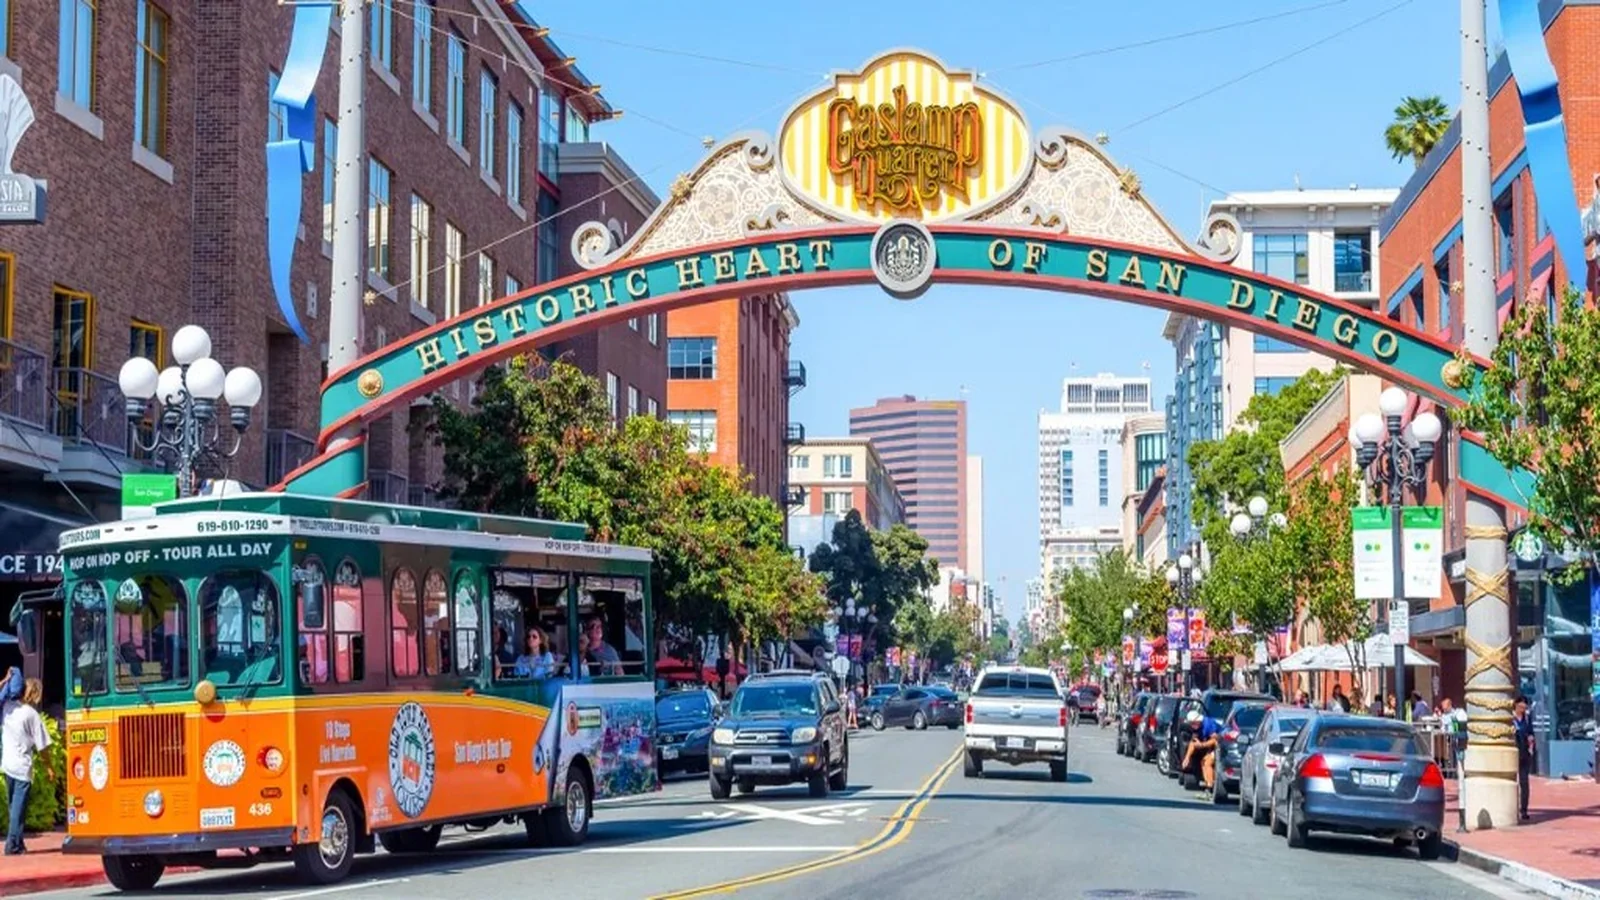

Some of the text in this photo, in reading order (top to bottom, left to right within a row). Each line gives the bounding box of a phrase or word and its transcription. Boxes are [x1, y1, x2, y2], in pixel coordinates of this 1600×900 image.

[828, 84, 980, 190] Gaslamp
[853, 146, 957, 207] Quarter
[414, 239, 1399, 371] HISTORIC HEART OF SAN DIEGO
[197, 519, 269, 532] 619-610-1290
[70, 556, 86, 570] HOP
[86, 554, 98, 568] ON
[100, 552, 121, 566] HOP
[124, 549, 150, 564] OFF
[163, 546, 202, 561] TOUR
[207, 543, 237, 558] ALL
[240, 542, 273, 557] DAY
[1151, 654, 1168, 665] STOP
[72, 731, 85, 743] CITY
[389, 727, 400, 758] OLD
[248, 803, 273, 816] 436
